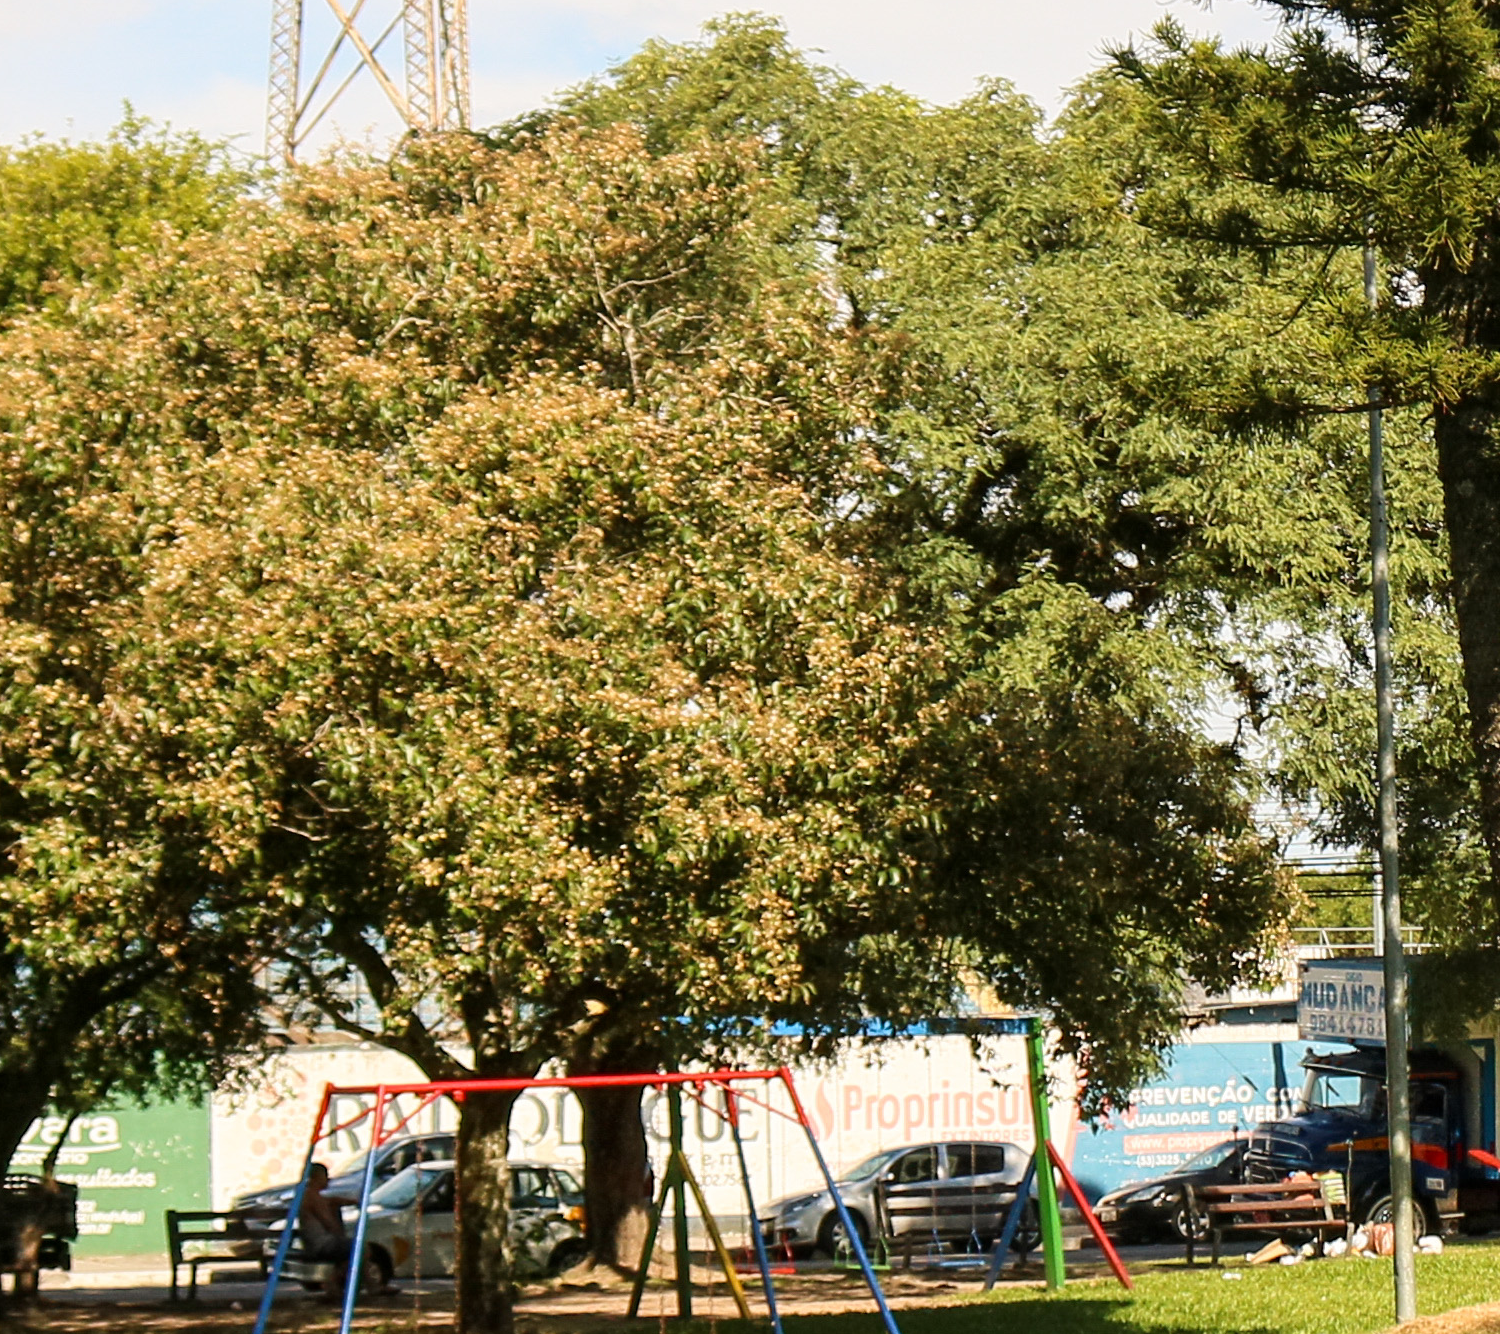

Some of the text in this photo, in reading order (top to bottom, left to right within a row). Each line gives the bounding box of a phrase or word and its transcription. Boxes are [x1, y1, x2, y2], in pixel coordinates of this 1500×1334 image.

[1300, 982, 1386, 1014] MUDANCA
[1128, 1078, 1254, 1107] PREVENÇÃO
[1218, 1109, 1238, 1124] DE
[941, 1131, 1031, 1142] EXTINTORES
